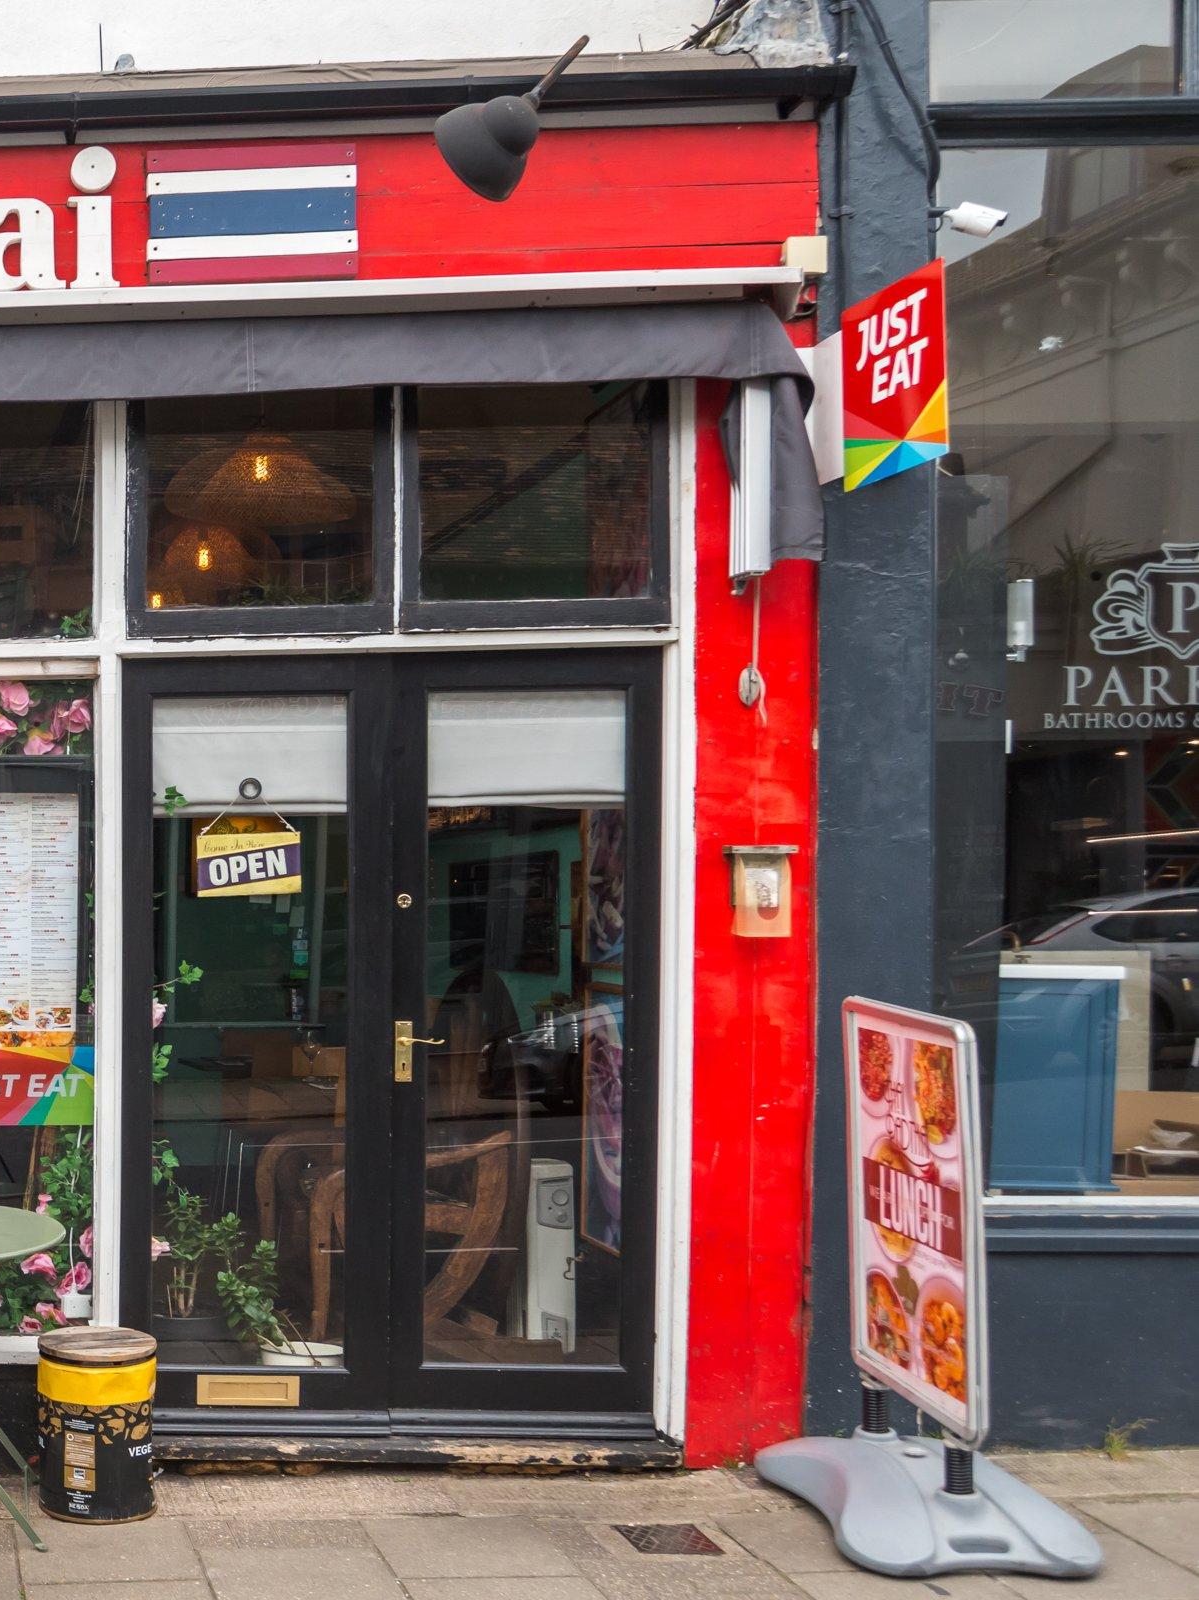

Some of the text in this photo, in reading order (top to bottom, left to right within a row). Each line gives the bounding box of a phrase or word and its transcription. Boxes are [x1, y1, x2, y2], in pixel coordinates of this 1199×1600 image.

[856, 287, 928, 371] JUST
[871, 337, 929, 404] EAT
[1044, 711, 1185, 729] BATHROOMS
[208, 848, 288, 886] OPEN
[26, 1073, 86, 1099] EAT
[879, 1164, 943, 1252] LUNCH
